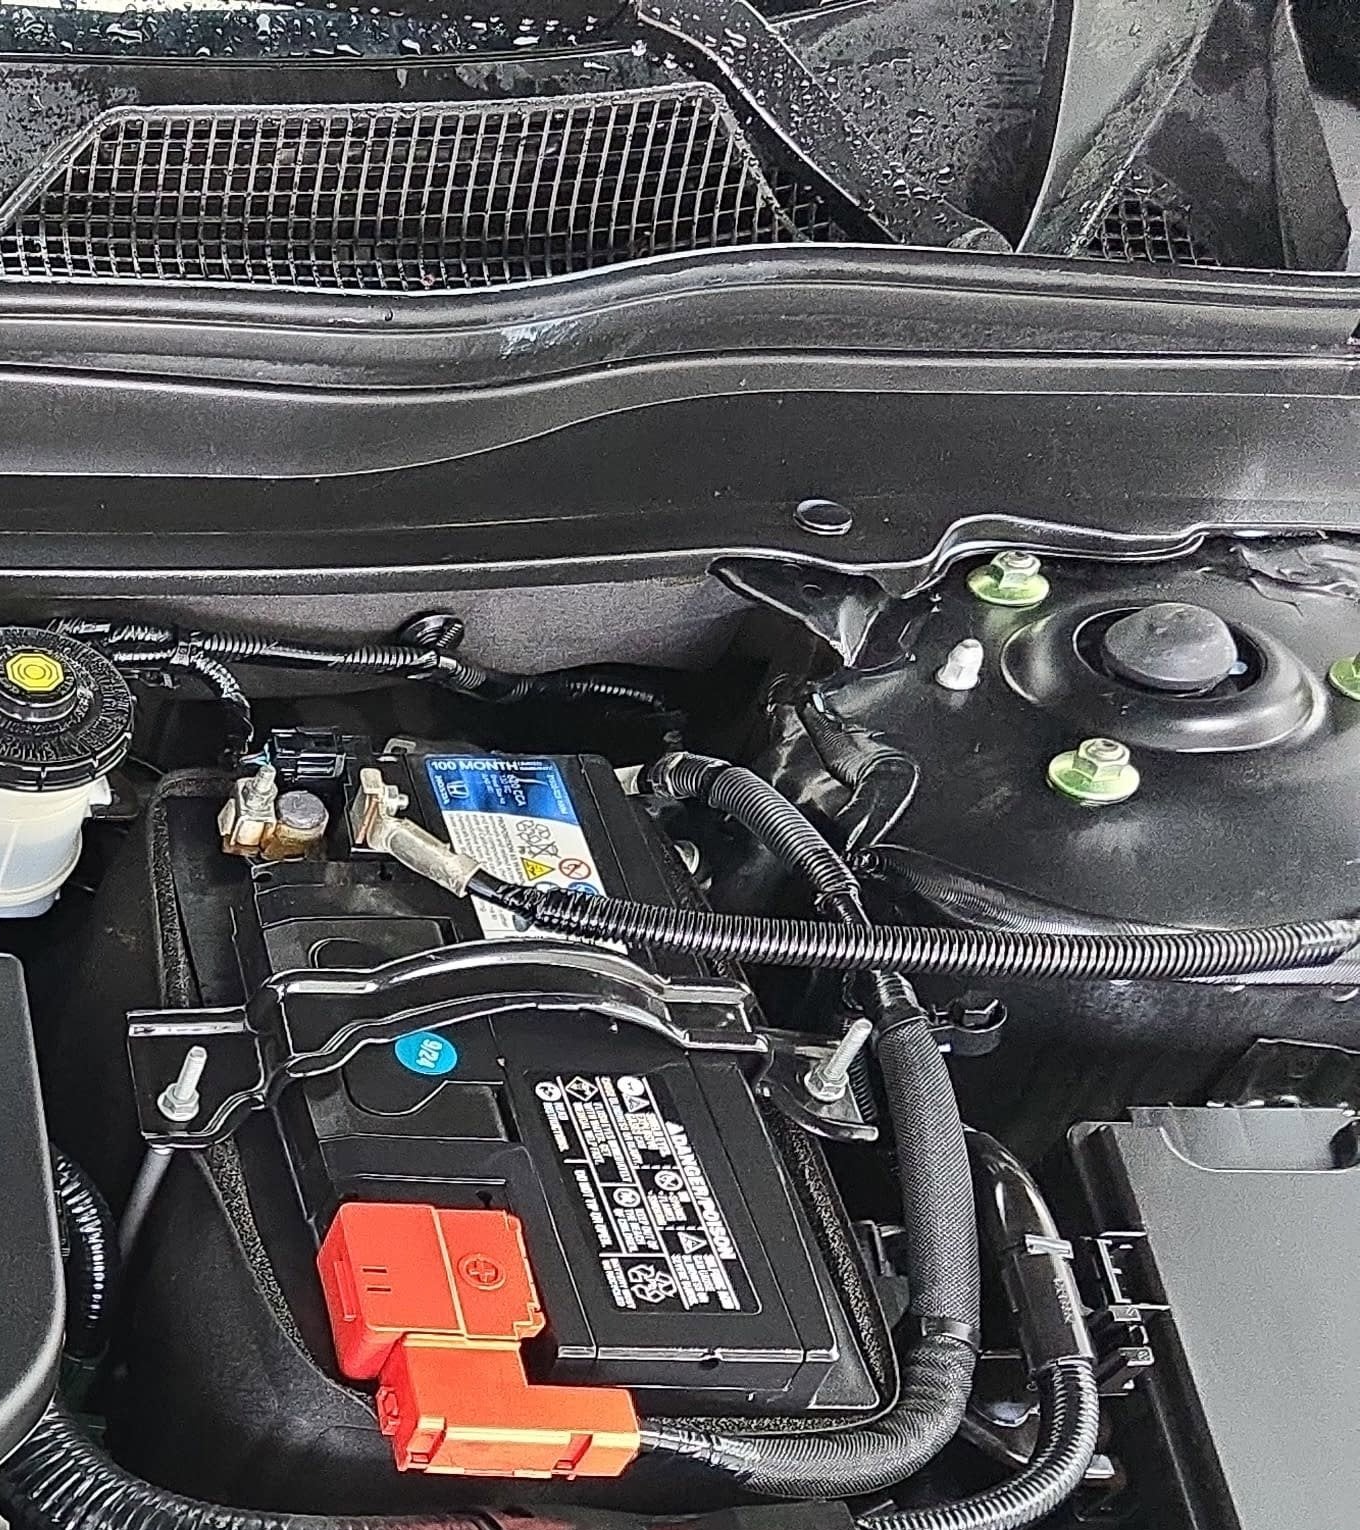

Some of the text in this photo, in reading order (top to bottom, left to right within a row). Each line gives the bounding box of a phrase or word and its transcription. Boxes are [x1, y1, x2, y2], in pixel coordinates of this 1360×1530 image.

[431, 761, 518, 771] 100 MONTH
[415, 1038, 443, 1069] 9/24
